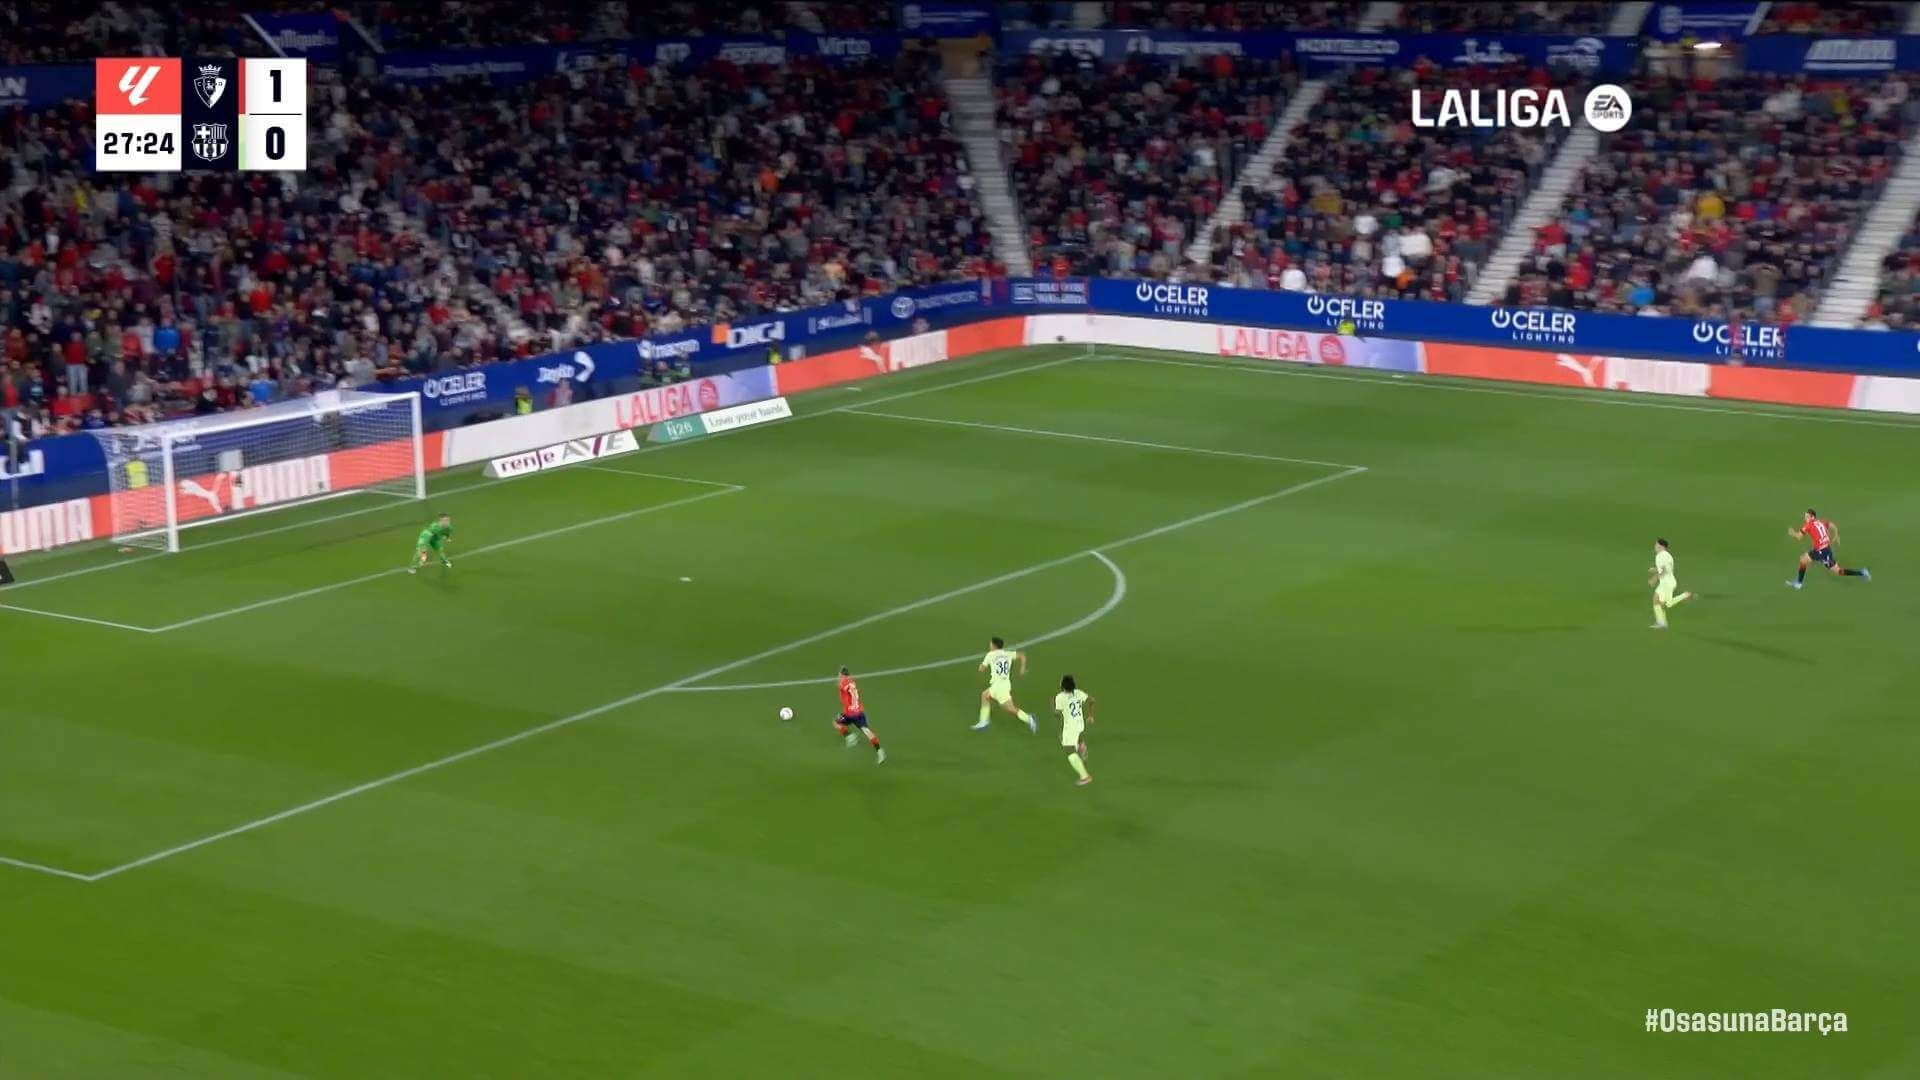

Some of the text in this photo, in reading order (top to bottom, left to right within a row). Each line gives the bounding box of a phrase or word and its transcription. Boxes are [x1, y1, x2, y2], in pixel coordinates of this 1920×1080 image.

[1154, 284, 1208, 306] CELER
[1154, 304, 1208, 316] LIGHTING
[1326, 317, 1384, 330] LITING
[1512, 311, 1576, 333] CELER
[1218, 328, 1312, 360] LALIGA
[1513, 331, 1575, 344] LIGHTING
[440, 372, 487, 396] CELER
[616, 385, 693, 429] LALIGA
[501, 450, 555, 472] renfe
[996, 661, 1009, 675] 38
